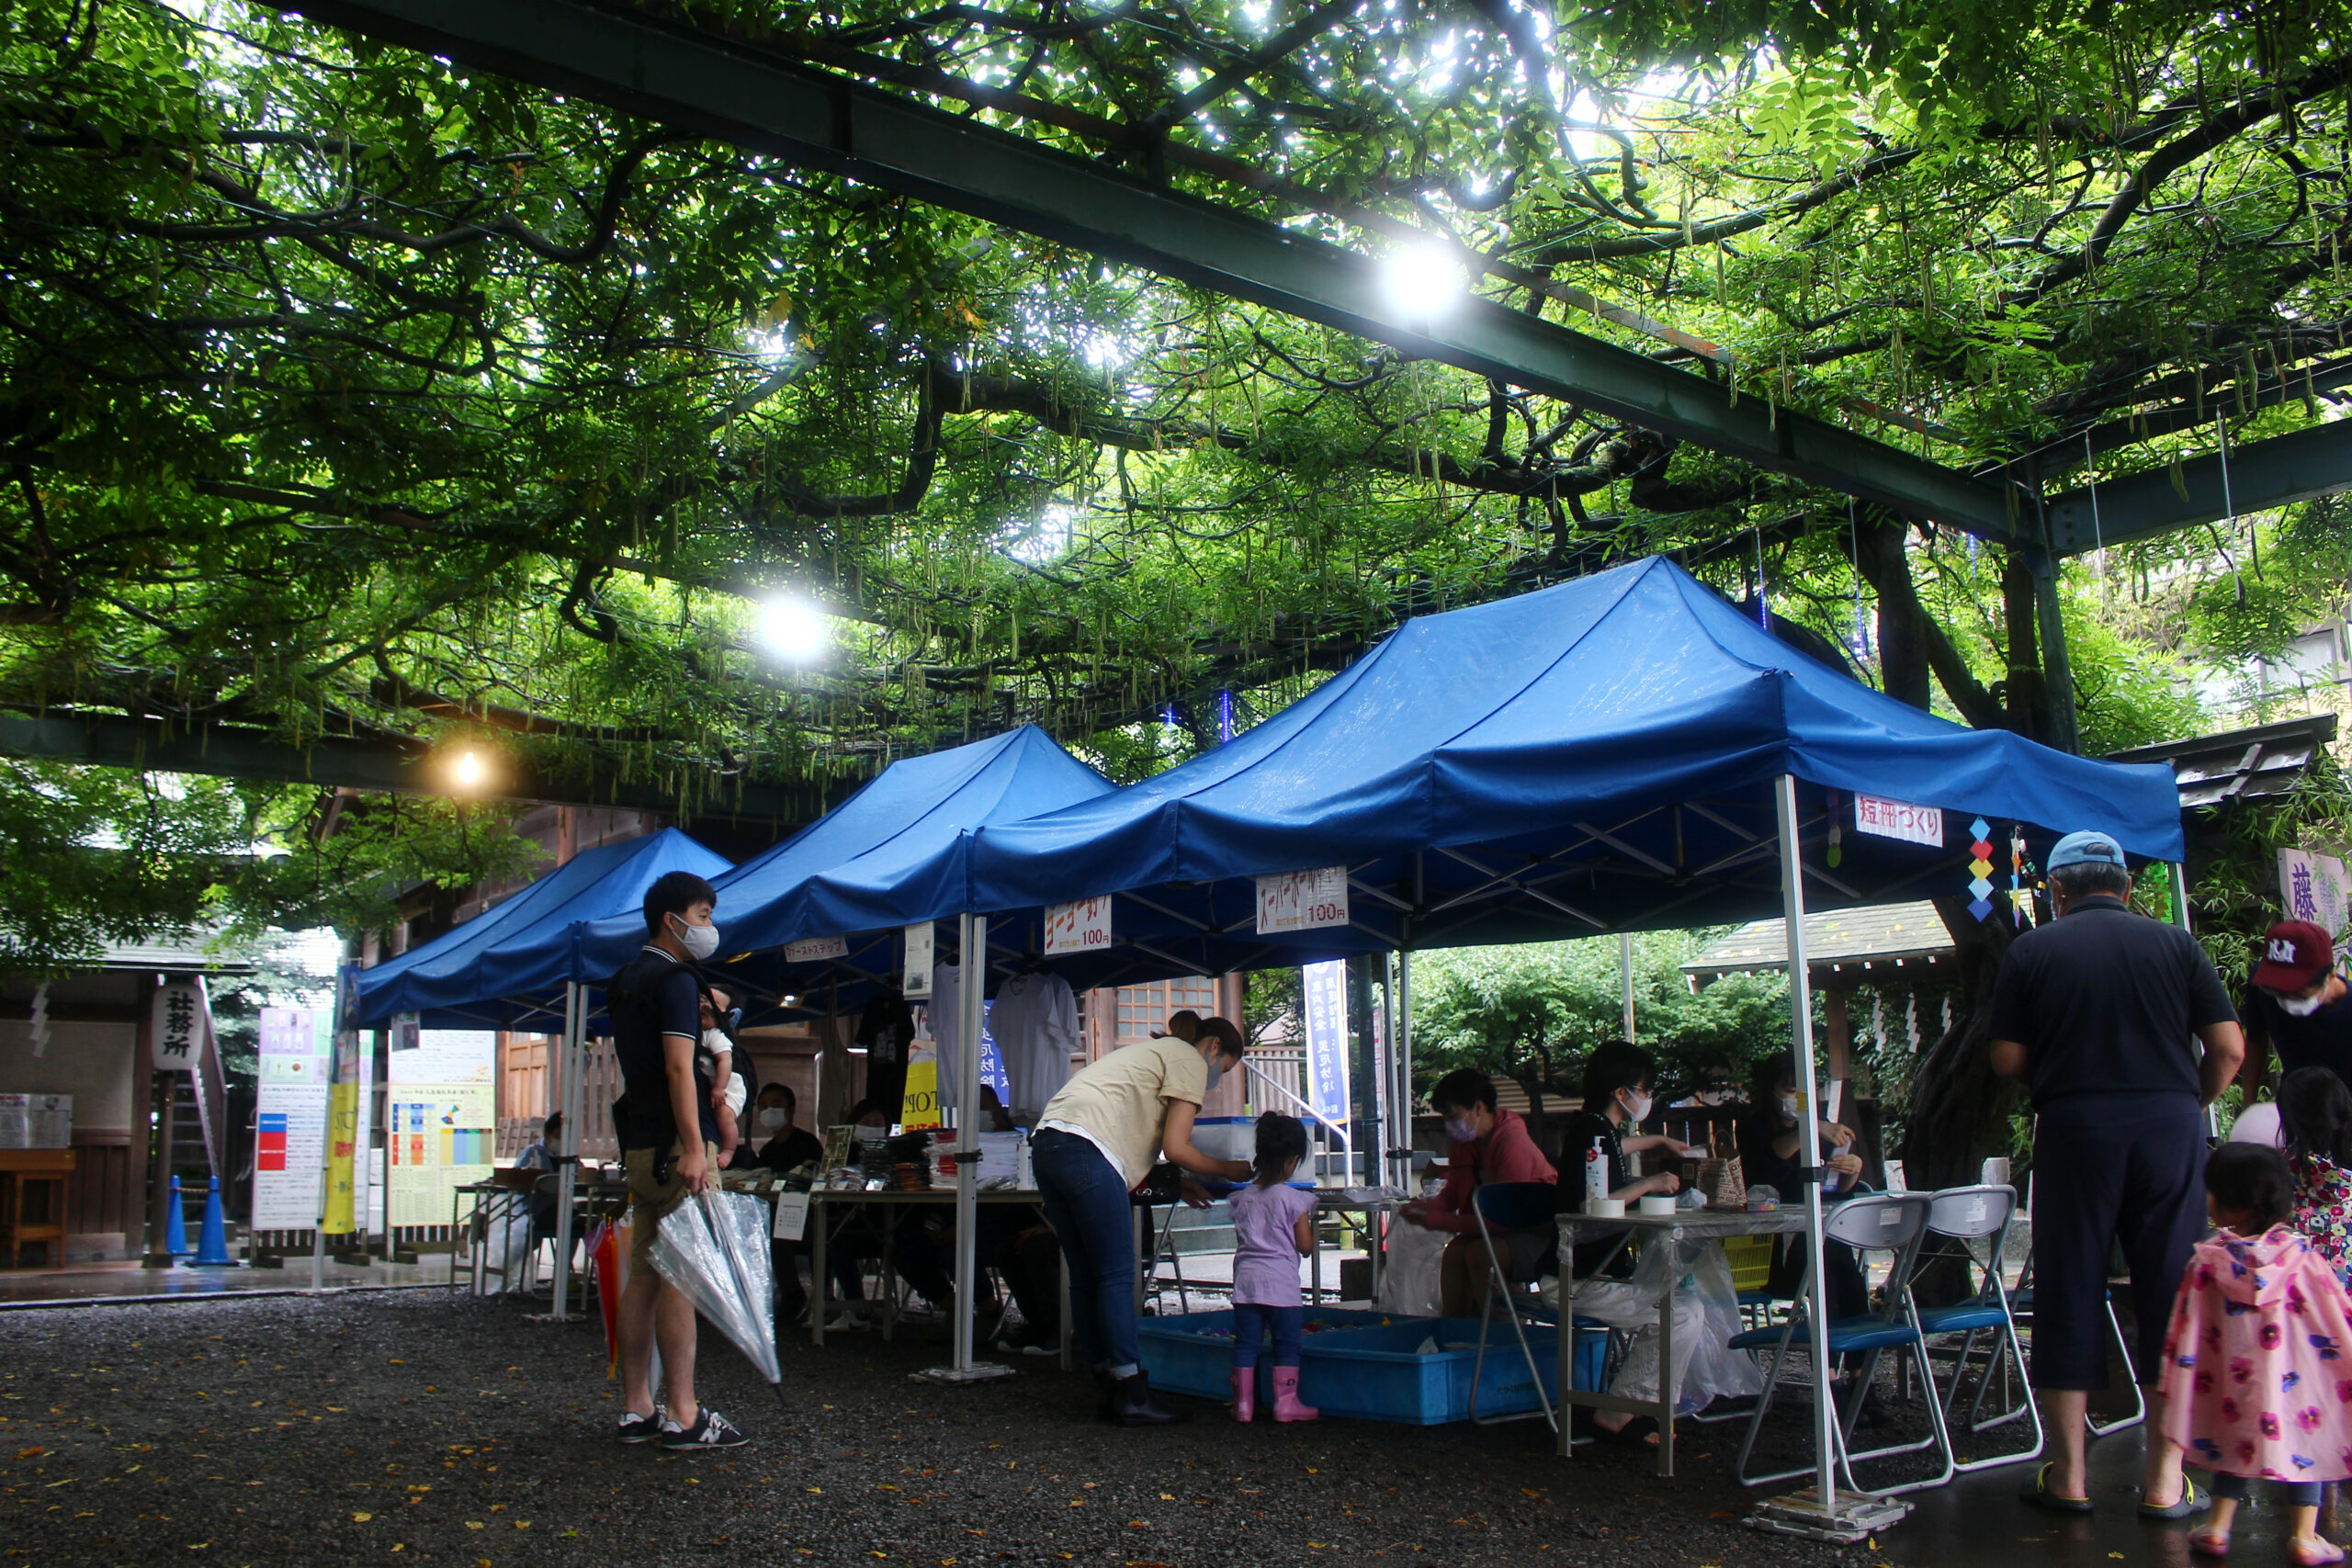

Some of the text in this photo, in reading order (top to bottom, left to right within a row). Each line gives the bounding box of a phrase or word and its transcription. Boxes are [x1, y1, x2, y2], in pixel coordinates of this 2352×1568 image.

[1859, 795, 1938, 837] 短冊づくり
[1307, 903, 1345, 922] 100円
[1082, 929, 1109, 945] 100円
[163, 990, 195, 1059] 社務所
